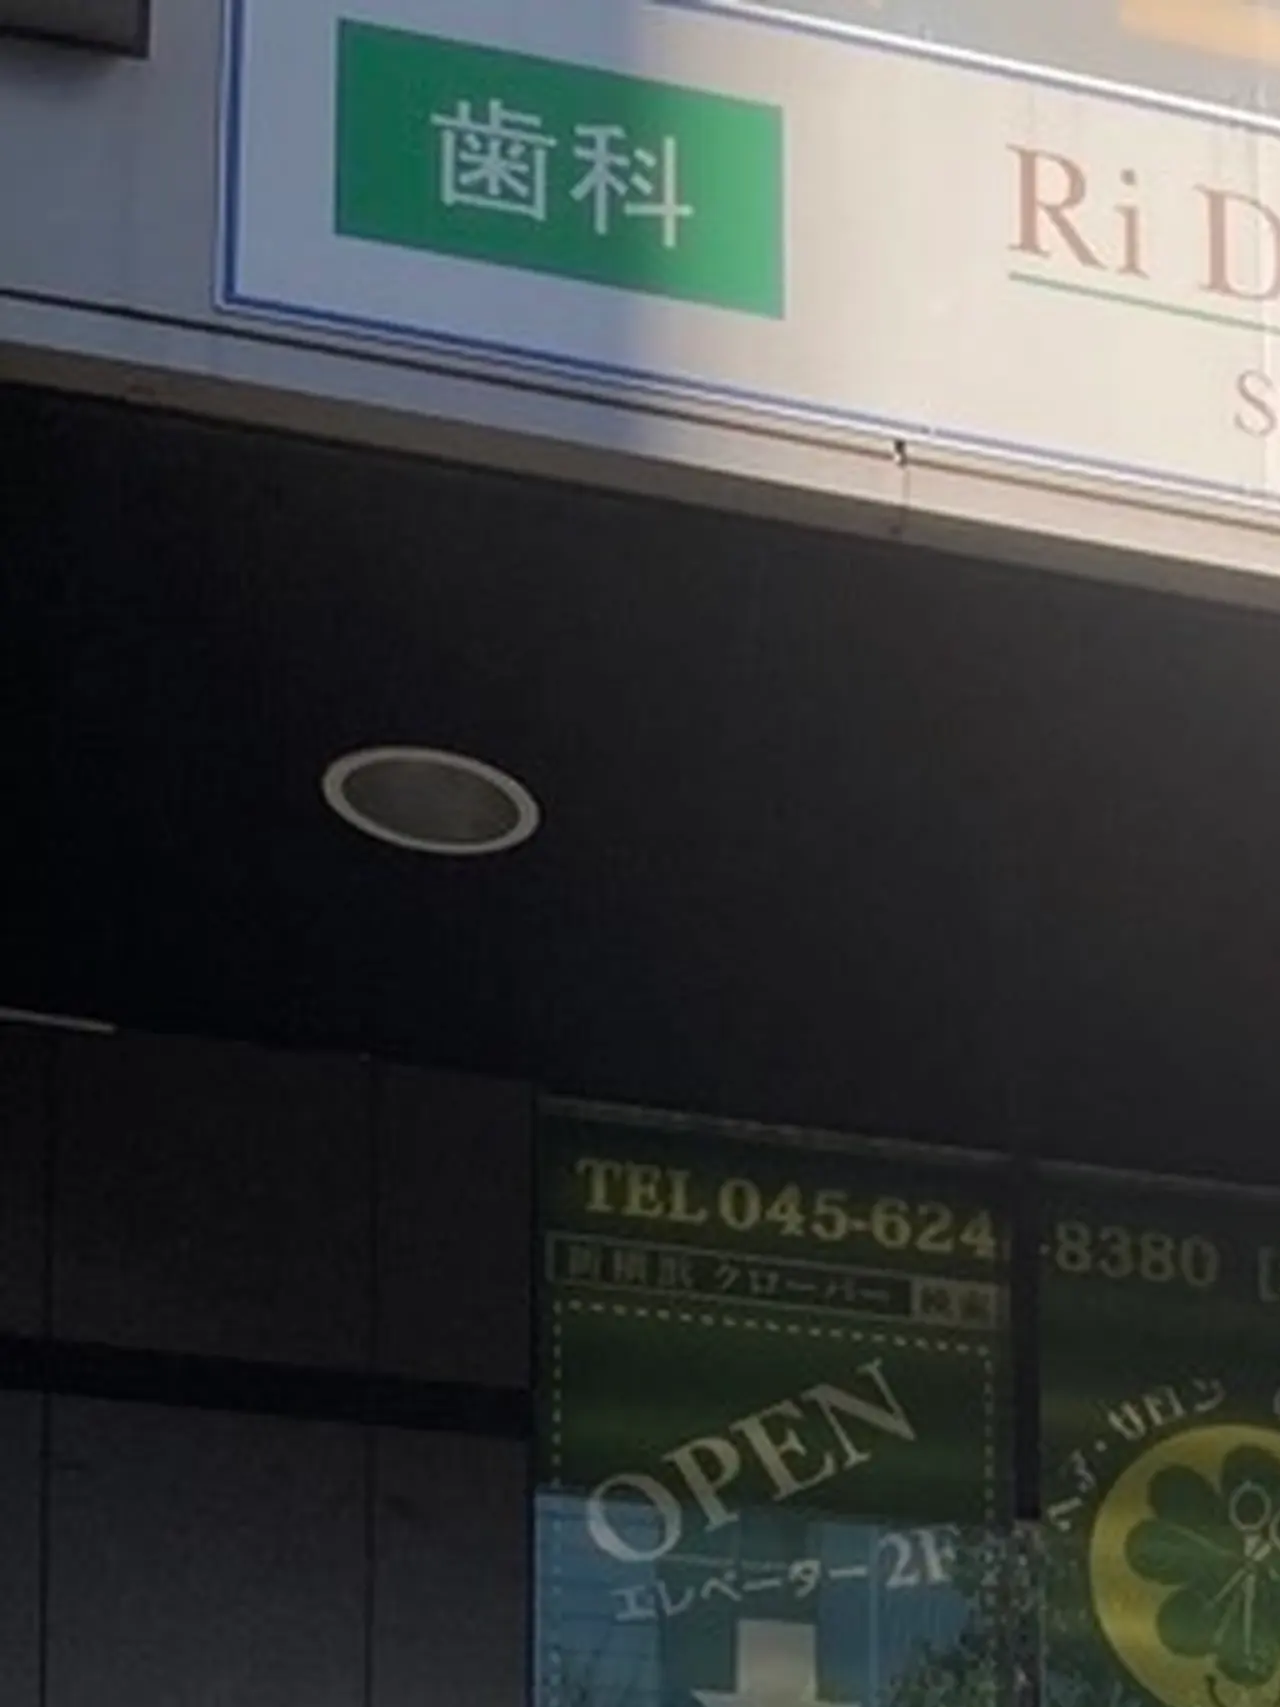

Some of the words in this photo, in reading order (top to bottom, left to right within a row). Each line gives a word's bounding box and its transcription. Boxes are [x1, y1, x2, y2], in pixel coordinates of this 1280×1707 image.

[432, 98, 694, 249] 歯科
[1008, 145, 1147, 276] Ri
[584, 1358, 918, 1563] OPEN
